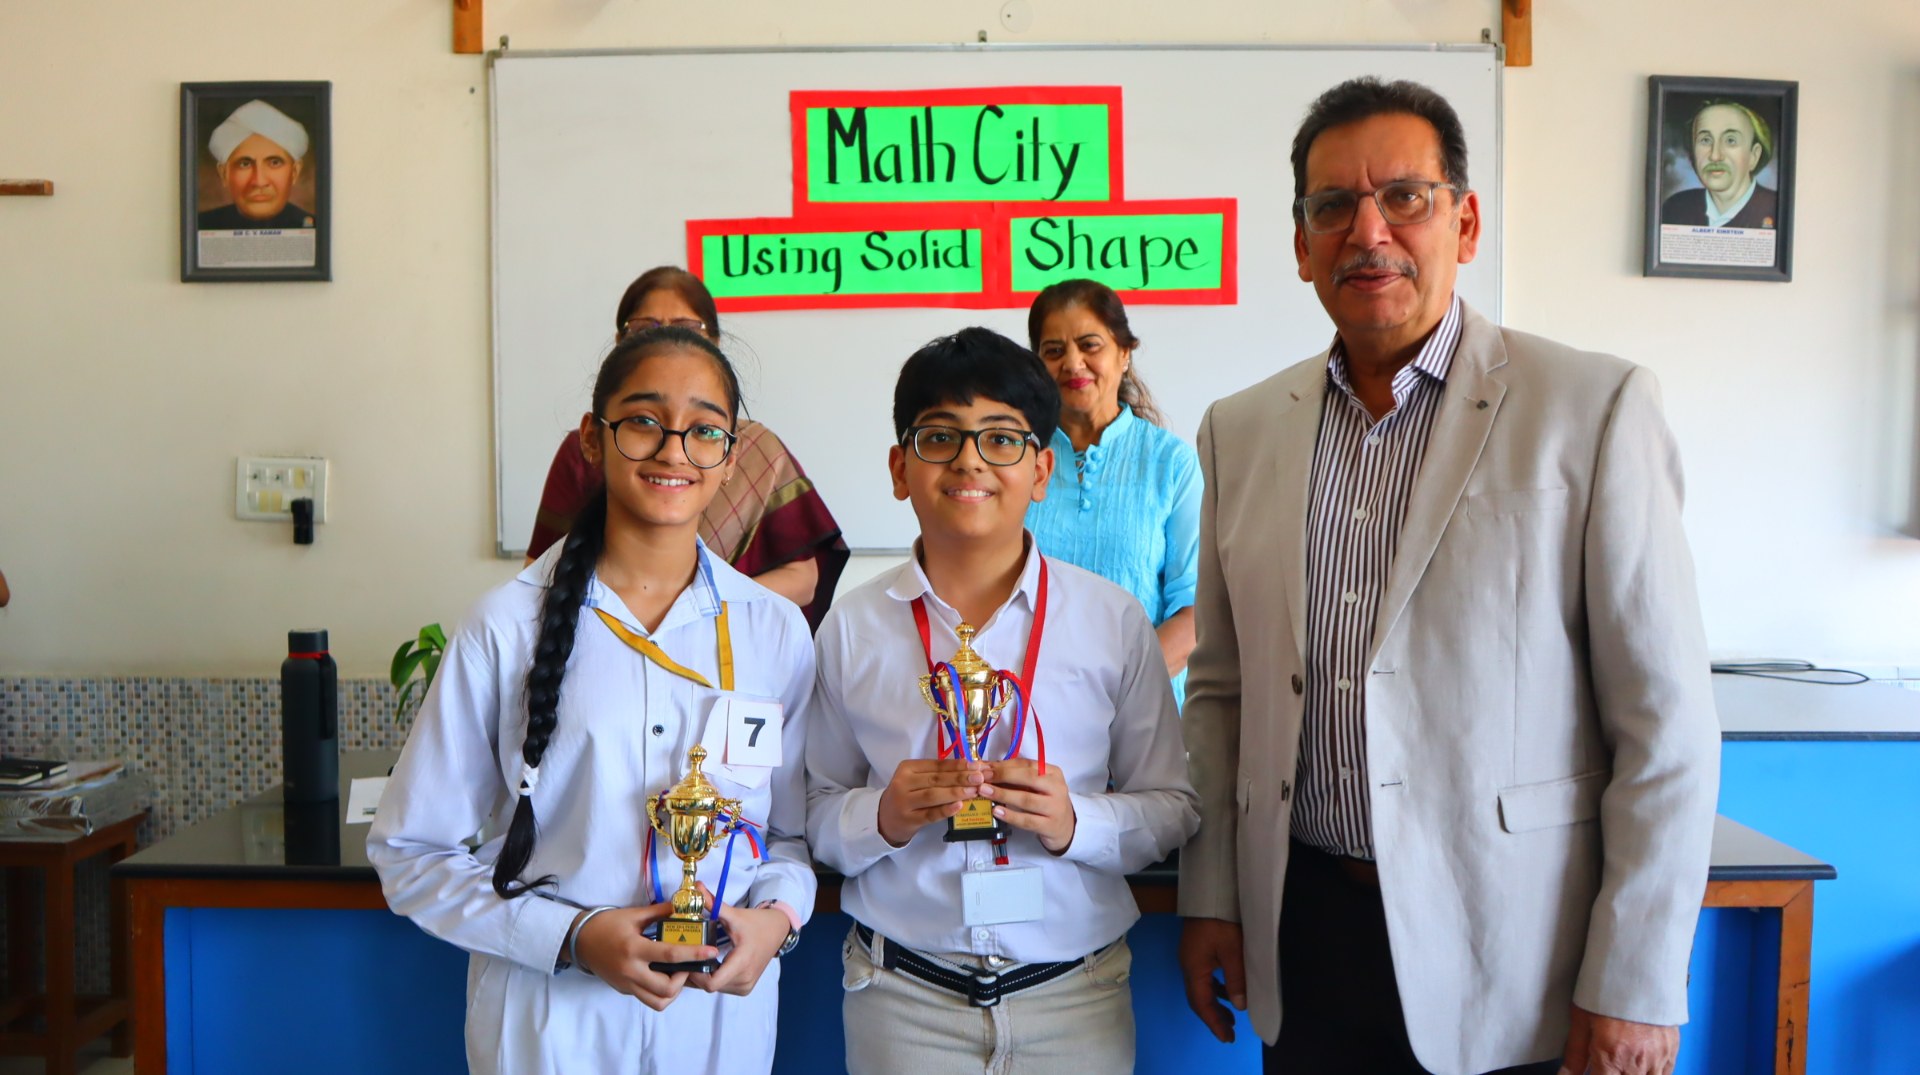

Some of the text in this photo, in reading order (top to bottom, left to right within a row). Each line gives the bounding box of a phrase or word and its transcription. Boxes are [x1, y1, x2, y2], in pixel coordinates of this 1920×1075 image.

[824, 104, 1089, 201] Math City
[720, 217, 1211, 294] Using Solid Shape
[744, 717, 765, 747] 7
